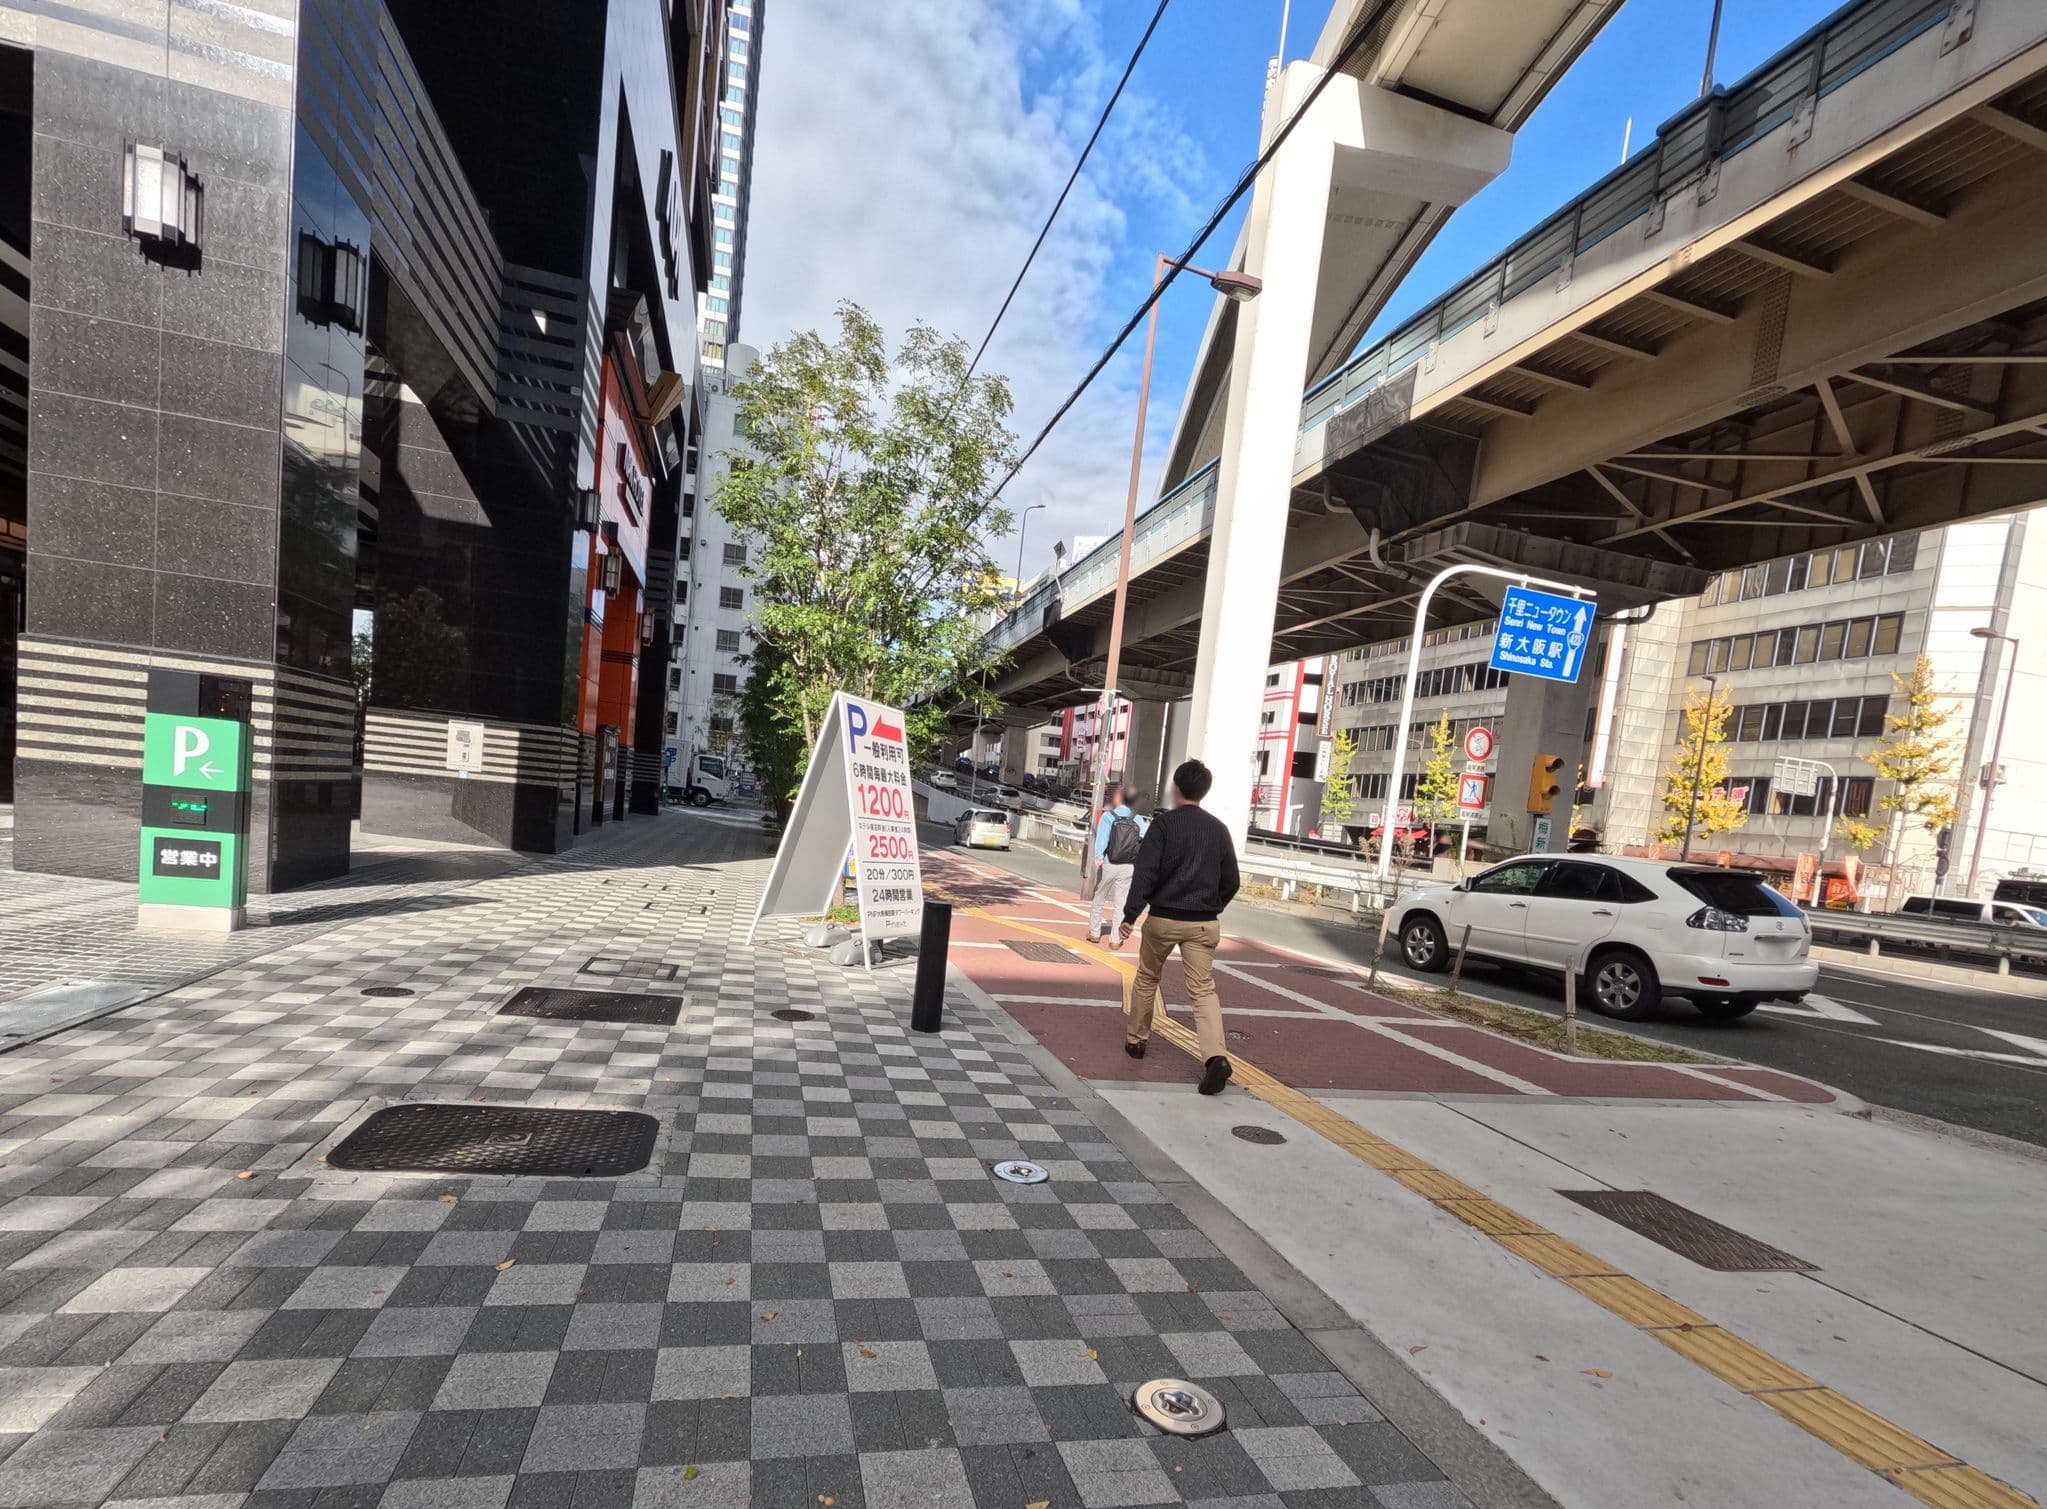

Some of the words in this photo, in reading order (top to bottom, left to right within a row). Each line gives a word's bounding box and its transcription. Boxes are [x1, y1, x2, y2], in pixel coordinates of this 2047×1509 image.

[1508, 597, 1572, 624] 千里ニュータウン
[1504, 615, 1524, 628] Senri
[1526, 620, 1544, 632] New
[1547, 624, 1567, 636] Town
[1499, 632, 1564, 659] 新大阪駅
[846, 702, 868, 755] P
[173, 725, 210, 777] P
[863, 741, 904, 765] 一般利用可
[160, 849, 218, 867] 営業中
[872, 887, 914, 902] 24時間営業
